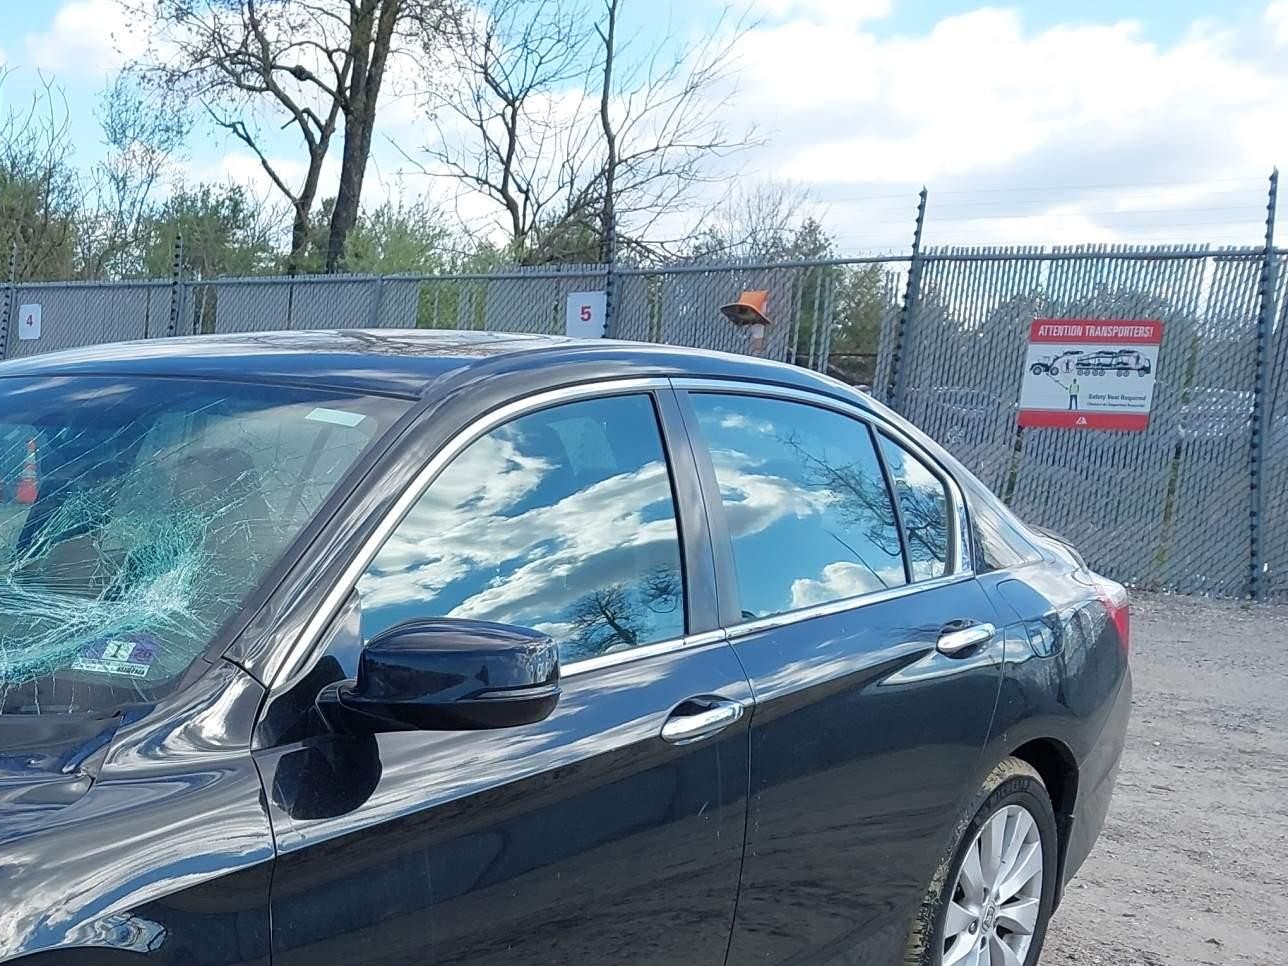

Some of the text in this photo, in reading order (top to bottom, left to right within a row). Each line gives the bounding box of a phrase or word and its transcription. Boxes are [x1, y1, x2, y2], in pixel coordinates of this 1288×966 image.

[580, 305, 592, 322] 5
[26, 314, 33, 327] 4
[1038, 325, 1154, 338] ATTENTION TRANSPORTERS!
